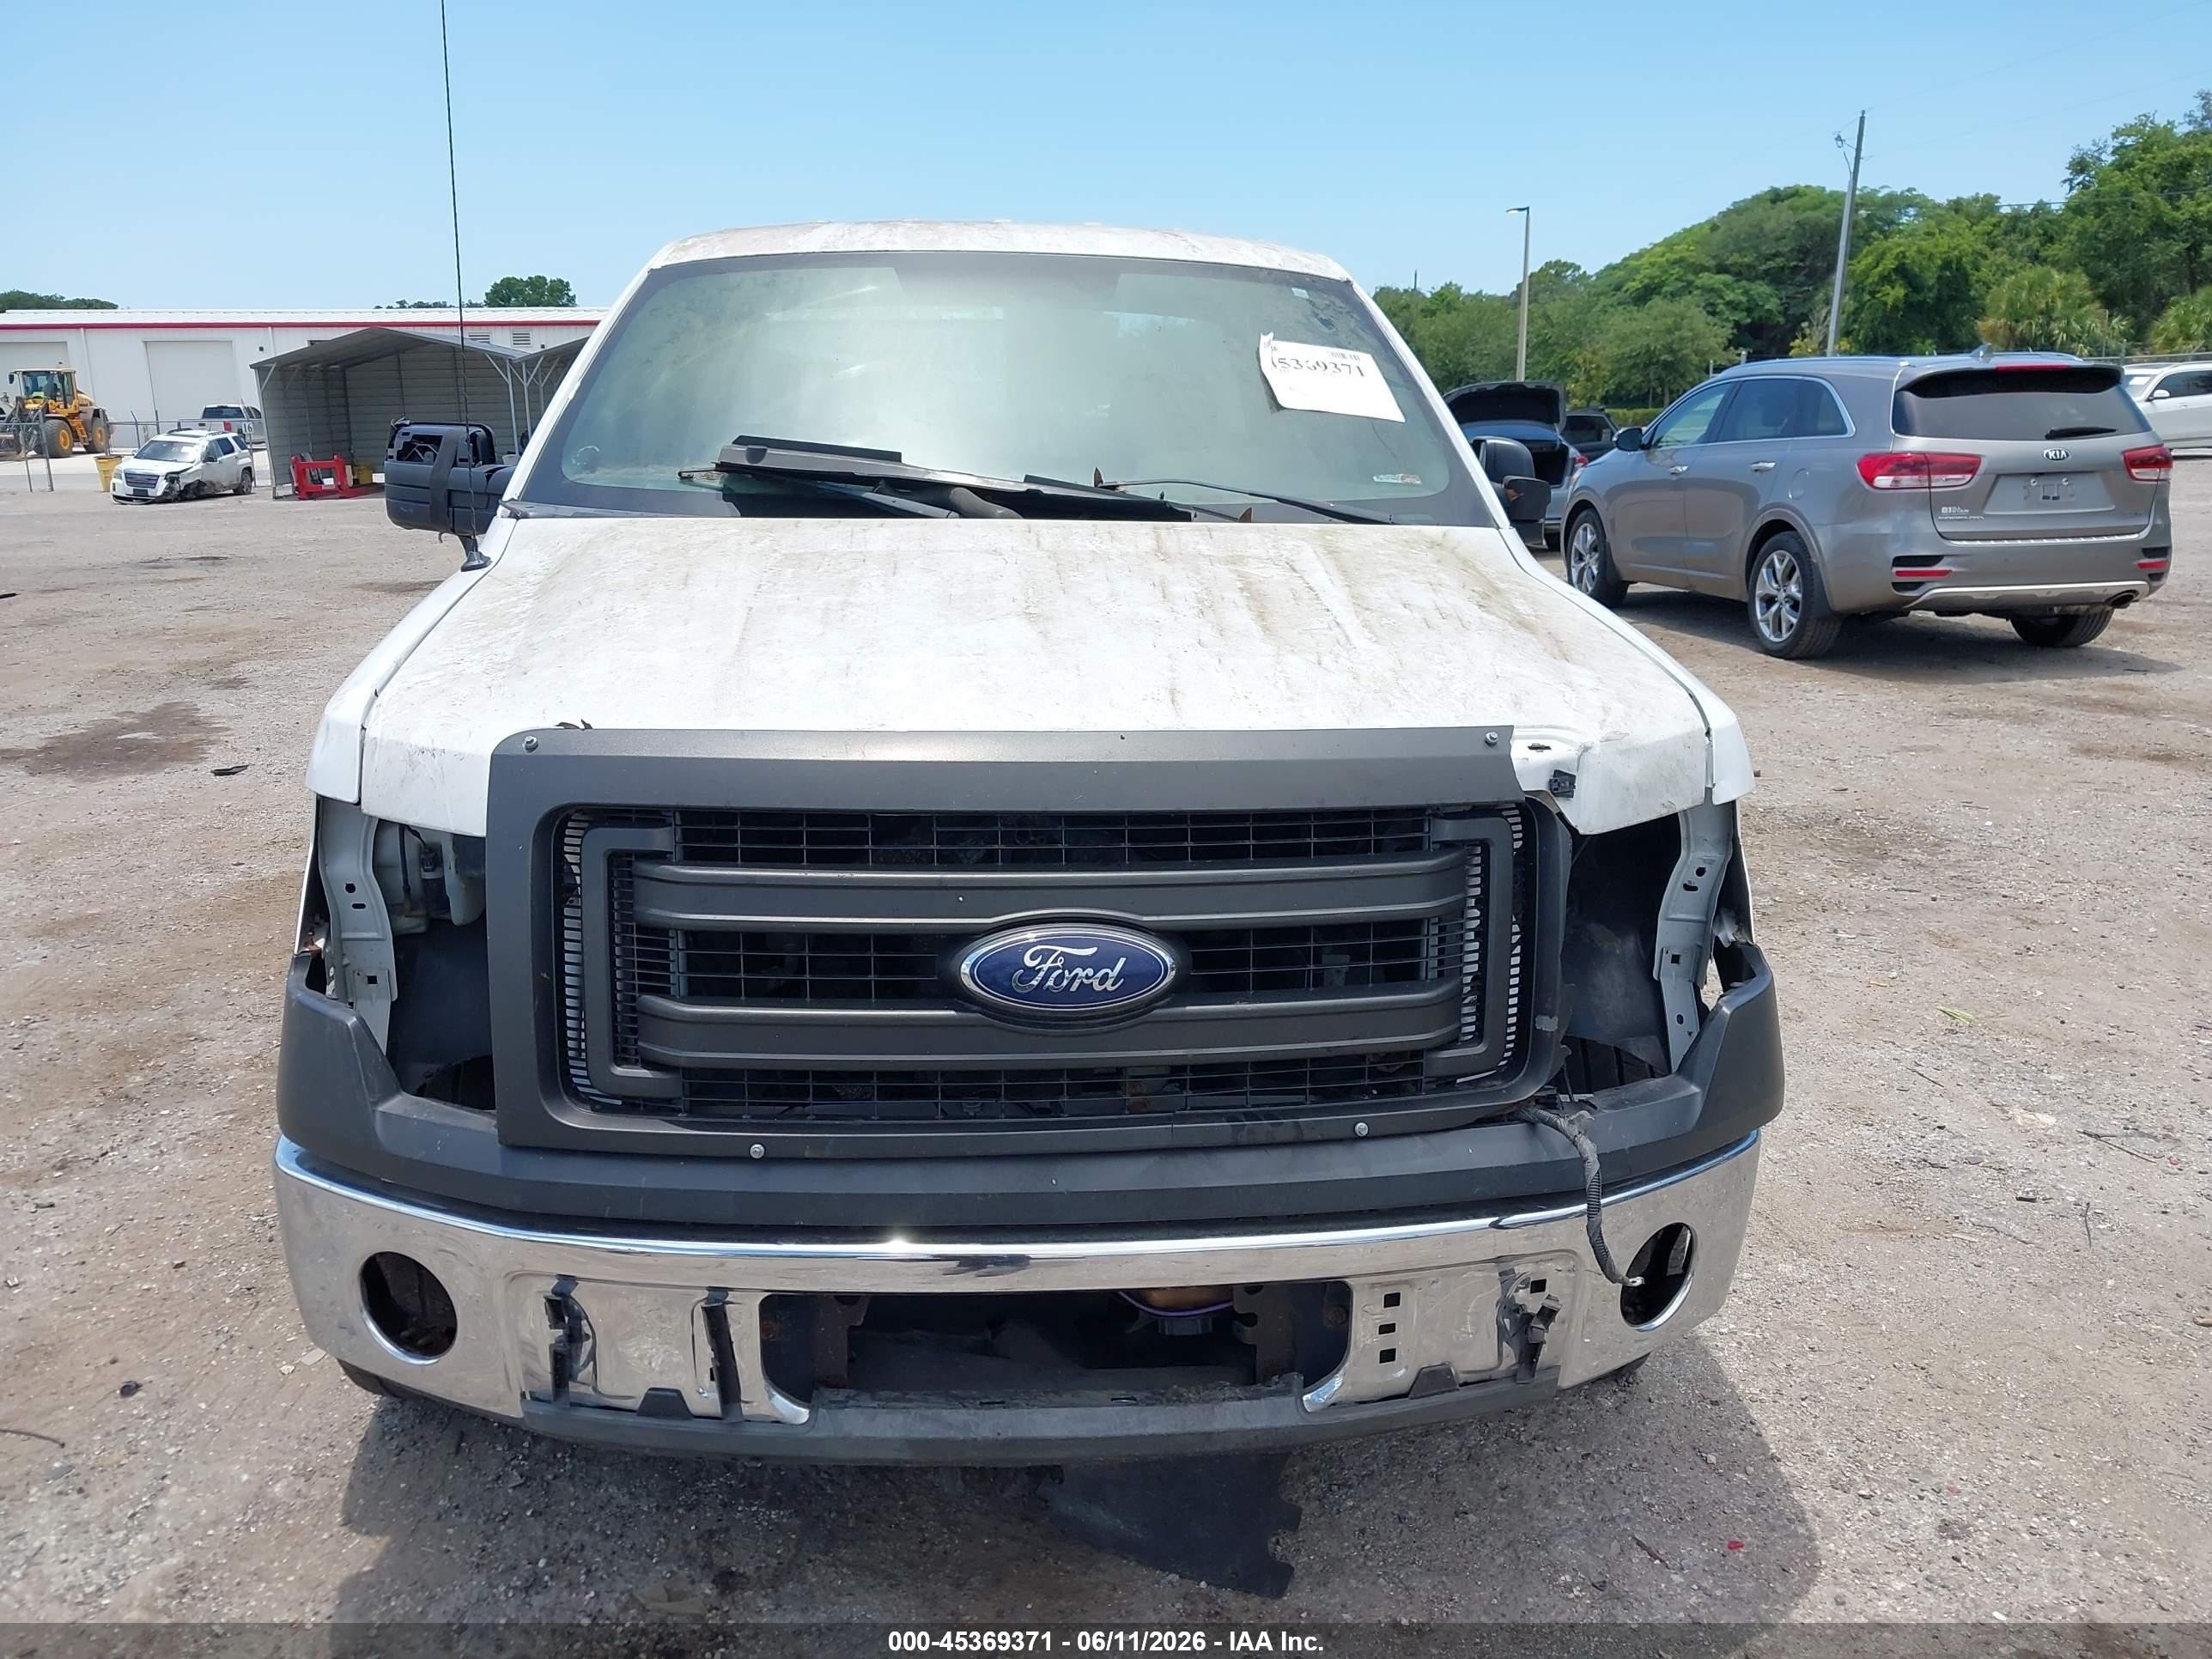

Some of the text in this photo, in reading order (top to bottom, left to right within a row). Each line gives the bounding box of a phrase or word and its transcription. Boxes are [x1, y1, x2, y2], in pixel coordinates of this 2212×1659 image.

[1271, 356, 1364, 377] 5369371
[244, 422, 253, 434] 16
[2048, 449, 2068, 460] KIA
[1012, 944, 1127, 994] Ford
